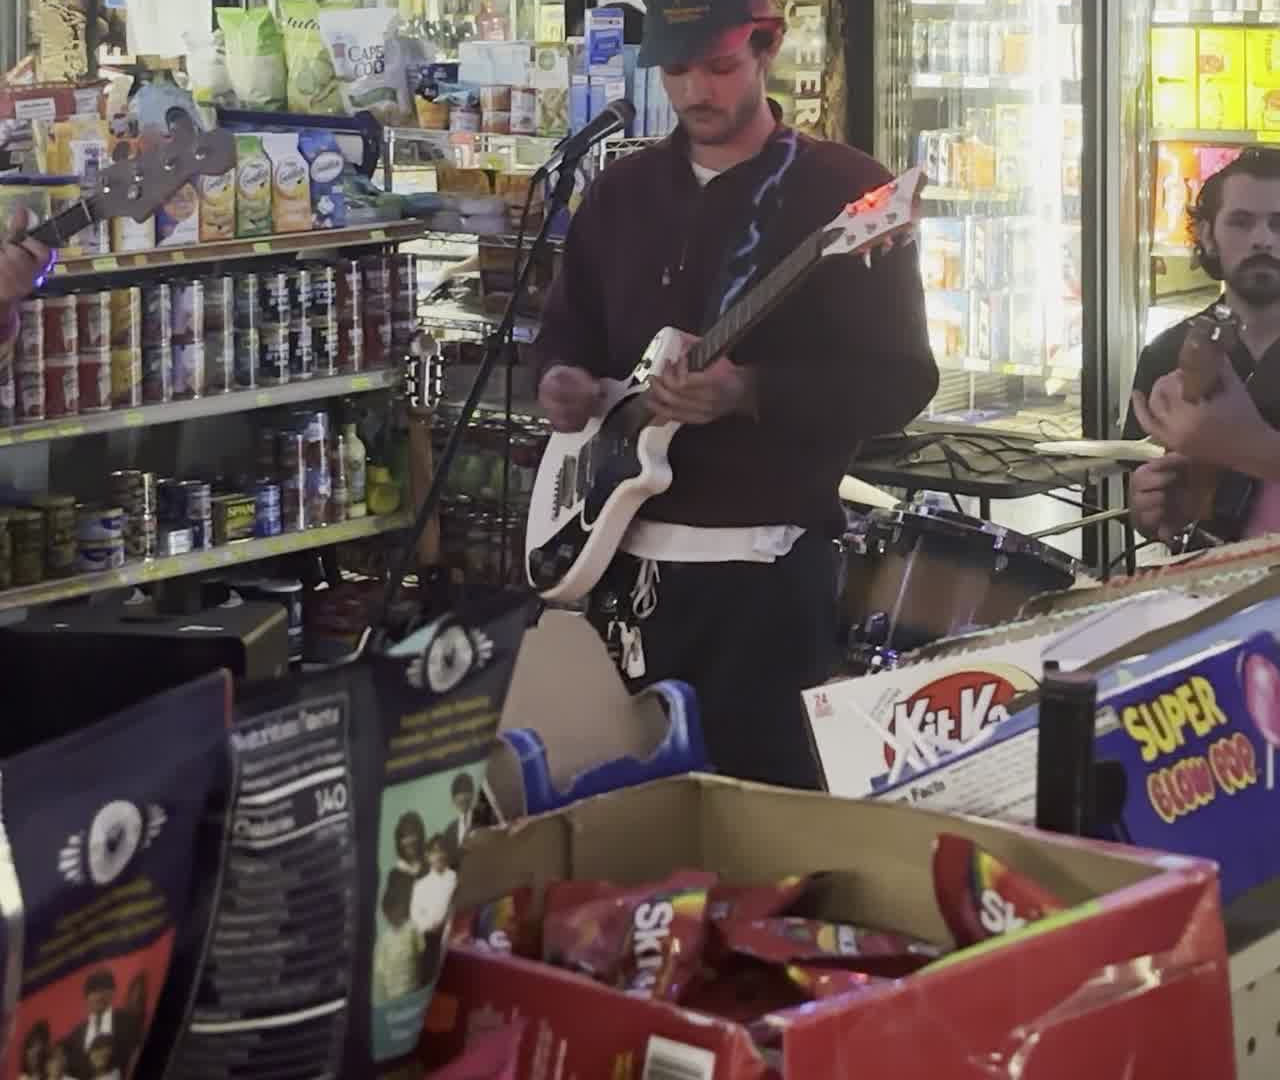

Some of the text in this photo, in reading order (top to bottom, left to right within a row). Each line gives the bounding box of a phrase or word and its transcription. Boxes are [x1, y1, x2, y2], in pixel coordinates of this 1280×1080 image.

[348, 45, 384, 61] CAPE
[959, 682, 1014, 743] Ka
[1123, 676, 1227, 763] SUPER
